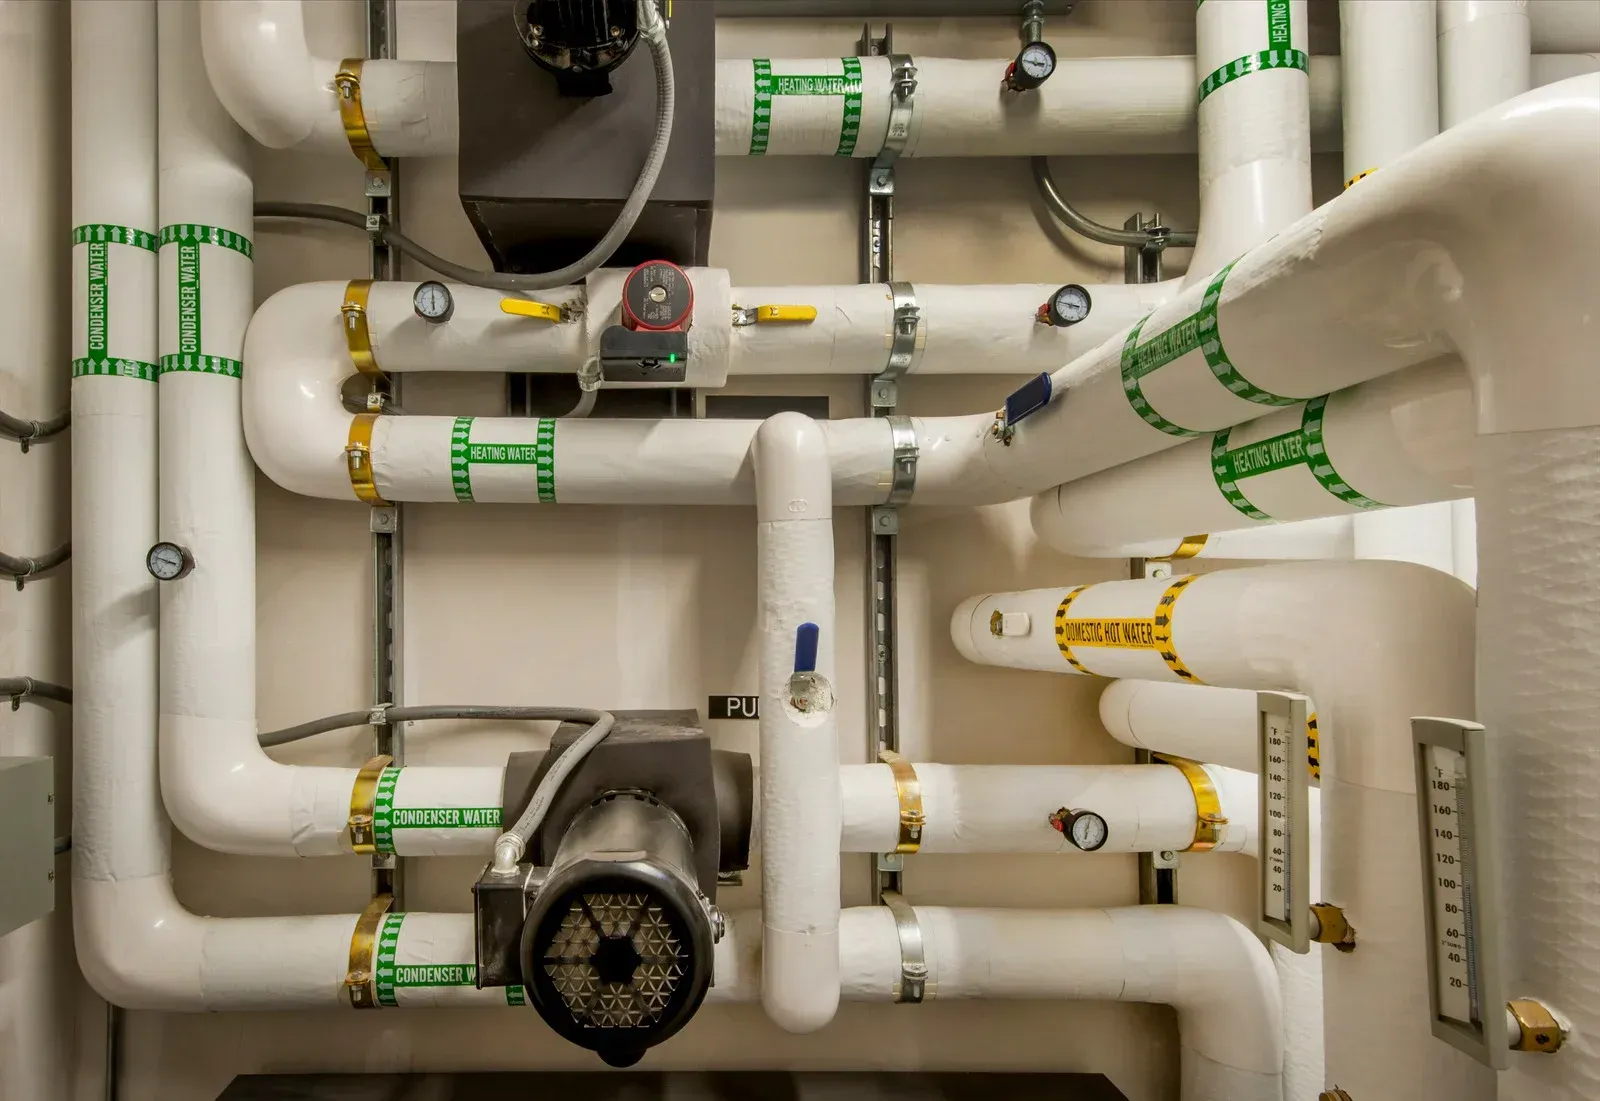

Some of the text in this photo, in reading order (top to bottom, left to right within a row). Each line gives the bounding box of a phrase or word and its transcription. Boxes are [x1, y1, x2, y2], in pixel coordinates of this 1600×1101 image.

[1271, 3, 1288, 43] HEATING
[778, 78, 844, 92] HEATING WATER
[90, 242, 105, 350] CONDENSER WATER
[181, 245, 197, 353] CONDENSER WATER
[1138, 319, 1198, 370] HEATING WATER
[470, 446, 537, 460] HEATING WATER
[1233, 436, 1305, 474] HEATING WATER
[1065, 622, 1155, 645] DOMESTIC HOT WATER
[727, 697, 760, 717] PU
[1269, 737, 1282, 746] 180
[1269, 755, 1282, 764] 160
[1269, 773, 1282, 782] 140
[1432, 780, 1450, 791] 180
[1269, 791, 1282, 801] 120
[1269, 809, 1282, 819] 100
[1433, 804, 1451, 816] 160
[393, 809, 501, 825] CONDENSER WATER
[1273, 828, 1282, 837] 80
[1435, 828, 1453, 840] 140
[1273, 847, 1282, 856] 60
[1436, 852, 1455, 865] 120
[1273, 865, 1282, 874] 40
[1273, 883, 1282, 893] 20
[1438, 877, 1456, 890] 100
[1445, 903, 1458, 914] 80
[1446, 927, 1459, 939] 60
[1448, 952, 1461, 963] 40
[396, 967, 463, 983] CONDENSER
[1449, 976, 1462, 988] 20
